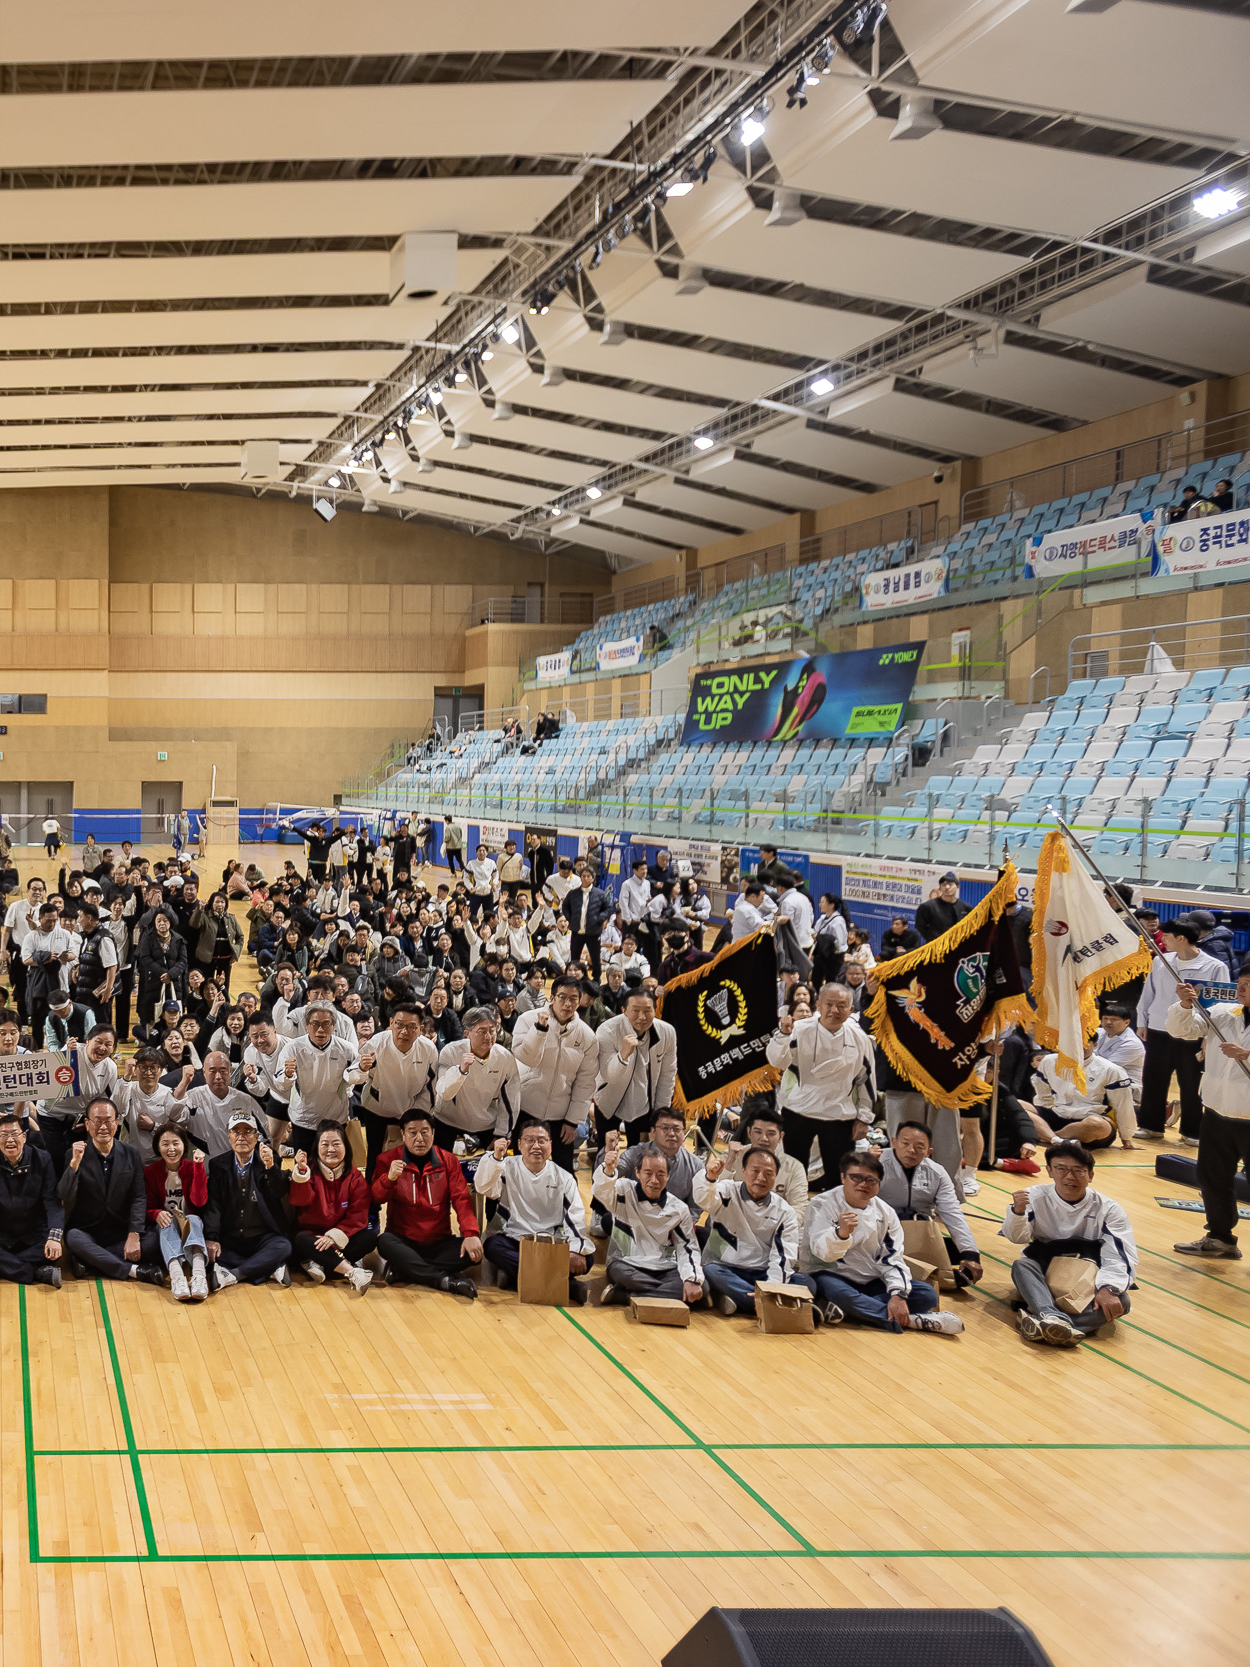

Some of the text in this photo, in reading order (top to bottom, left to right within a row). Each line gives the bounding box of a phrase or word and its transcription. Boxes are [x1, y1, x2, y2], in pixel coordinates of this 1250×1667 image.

[894, 649, 918, 663] YONEX
[711, 669, 779, 695] ONLY
[697, 692, 751, 713] WAY
[699, 711, 733, 730] UP
[1203, 987, 1238, 1000] 동국민턴
[697, 1029, 779, 1080] 중곡문화배드민턴
[952, 1031, 982, 1069] 자양
[57, 1068, 72, 1082] 승
